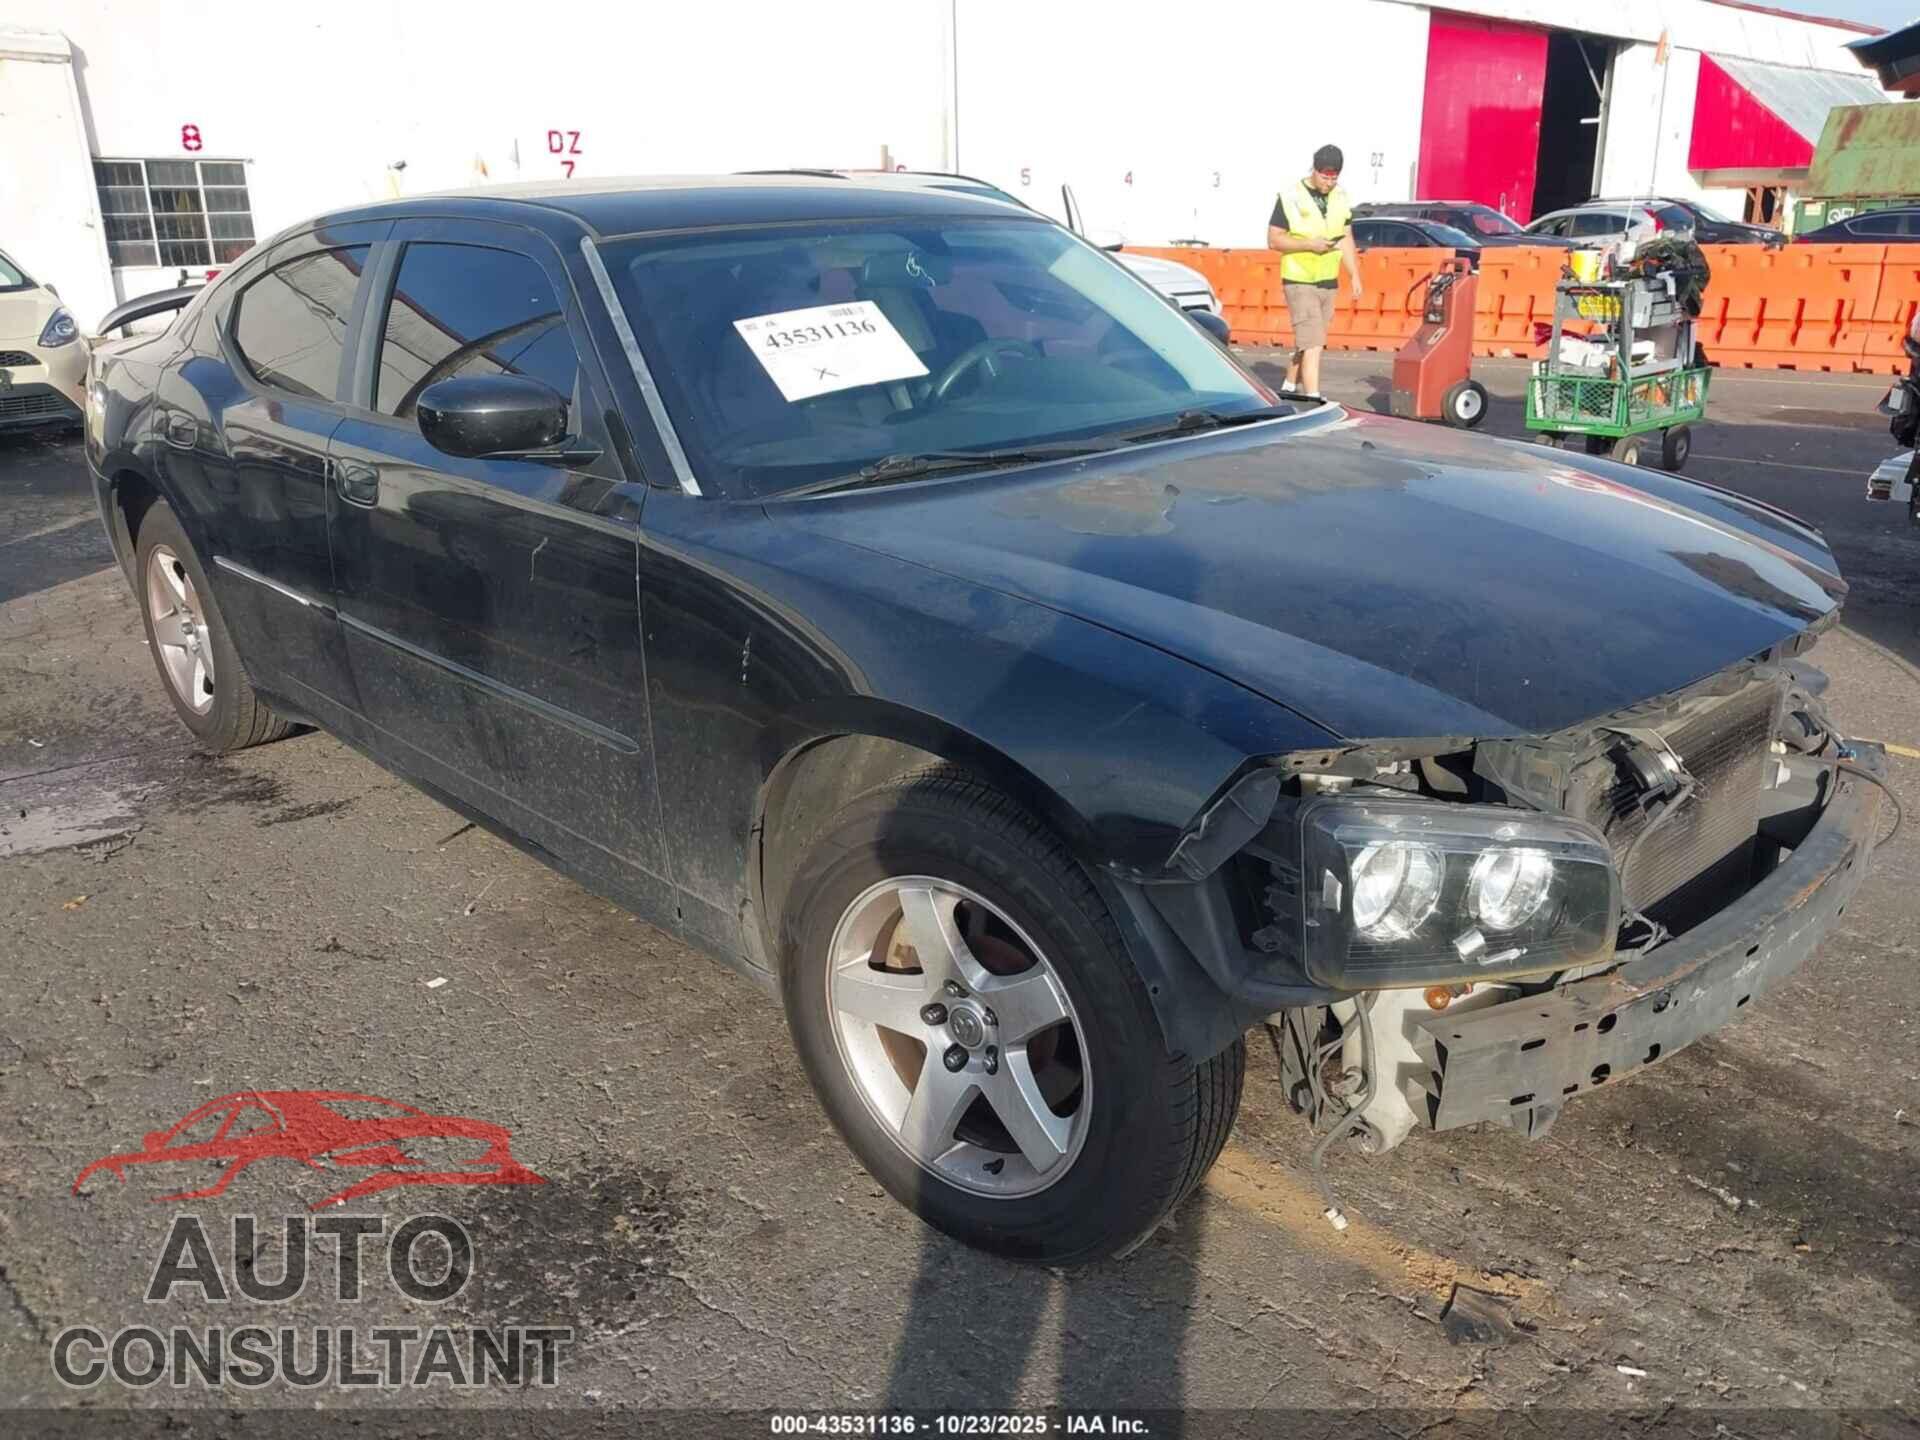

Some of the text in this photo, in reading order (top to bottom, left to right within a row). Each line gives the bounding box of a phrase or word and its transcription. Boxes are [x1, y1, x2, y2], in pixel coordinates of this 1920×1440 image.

[181, 124, 202, 152] 8
[548, 130, 582, 154] DZ
[561, 160, 575, 179] 7
[1020, 168, 1032, 187] 5
[1124, 170, 1133, 187] 4
[766, 319, 877, 348] 43531136
